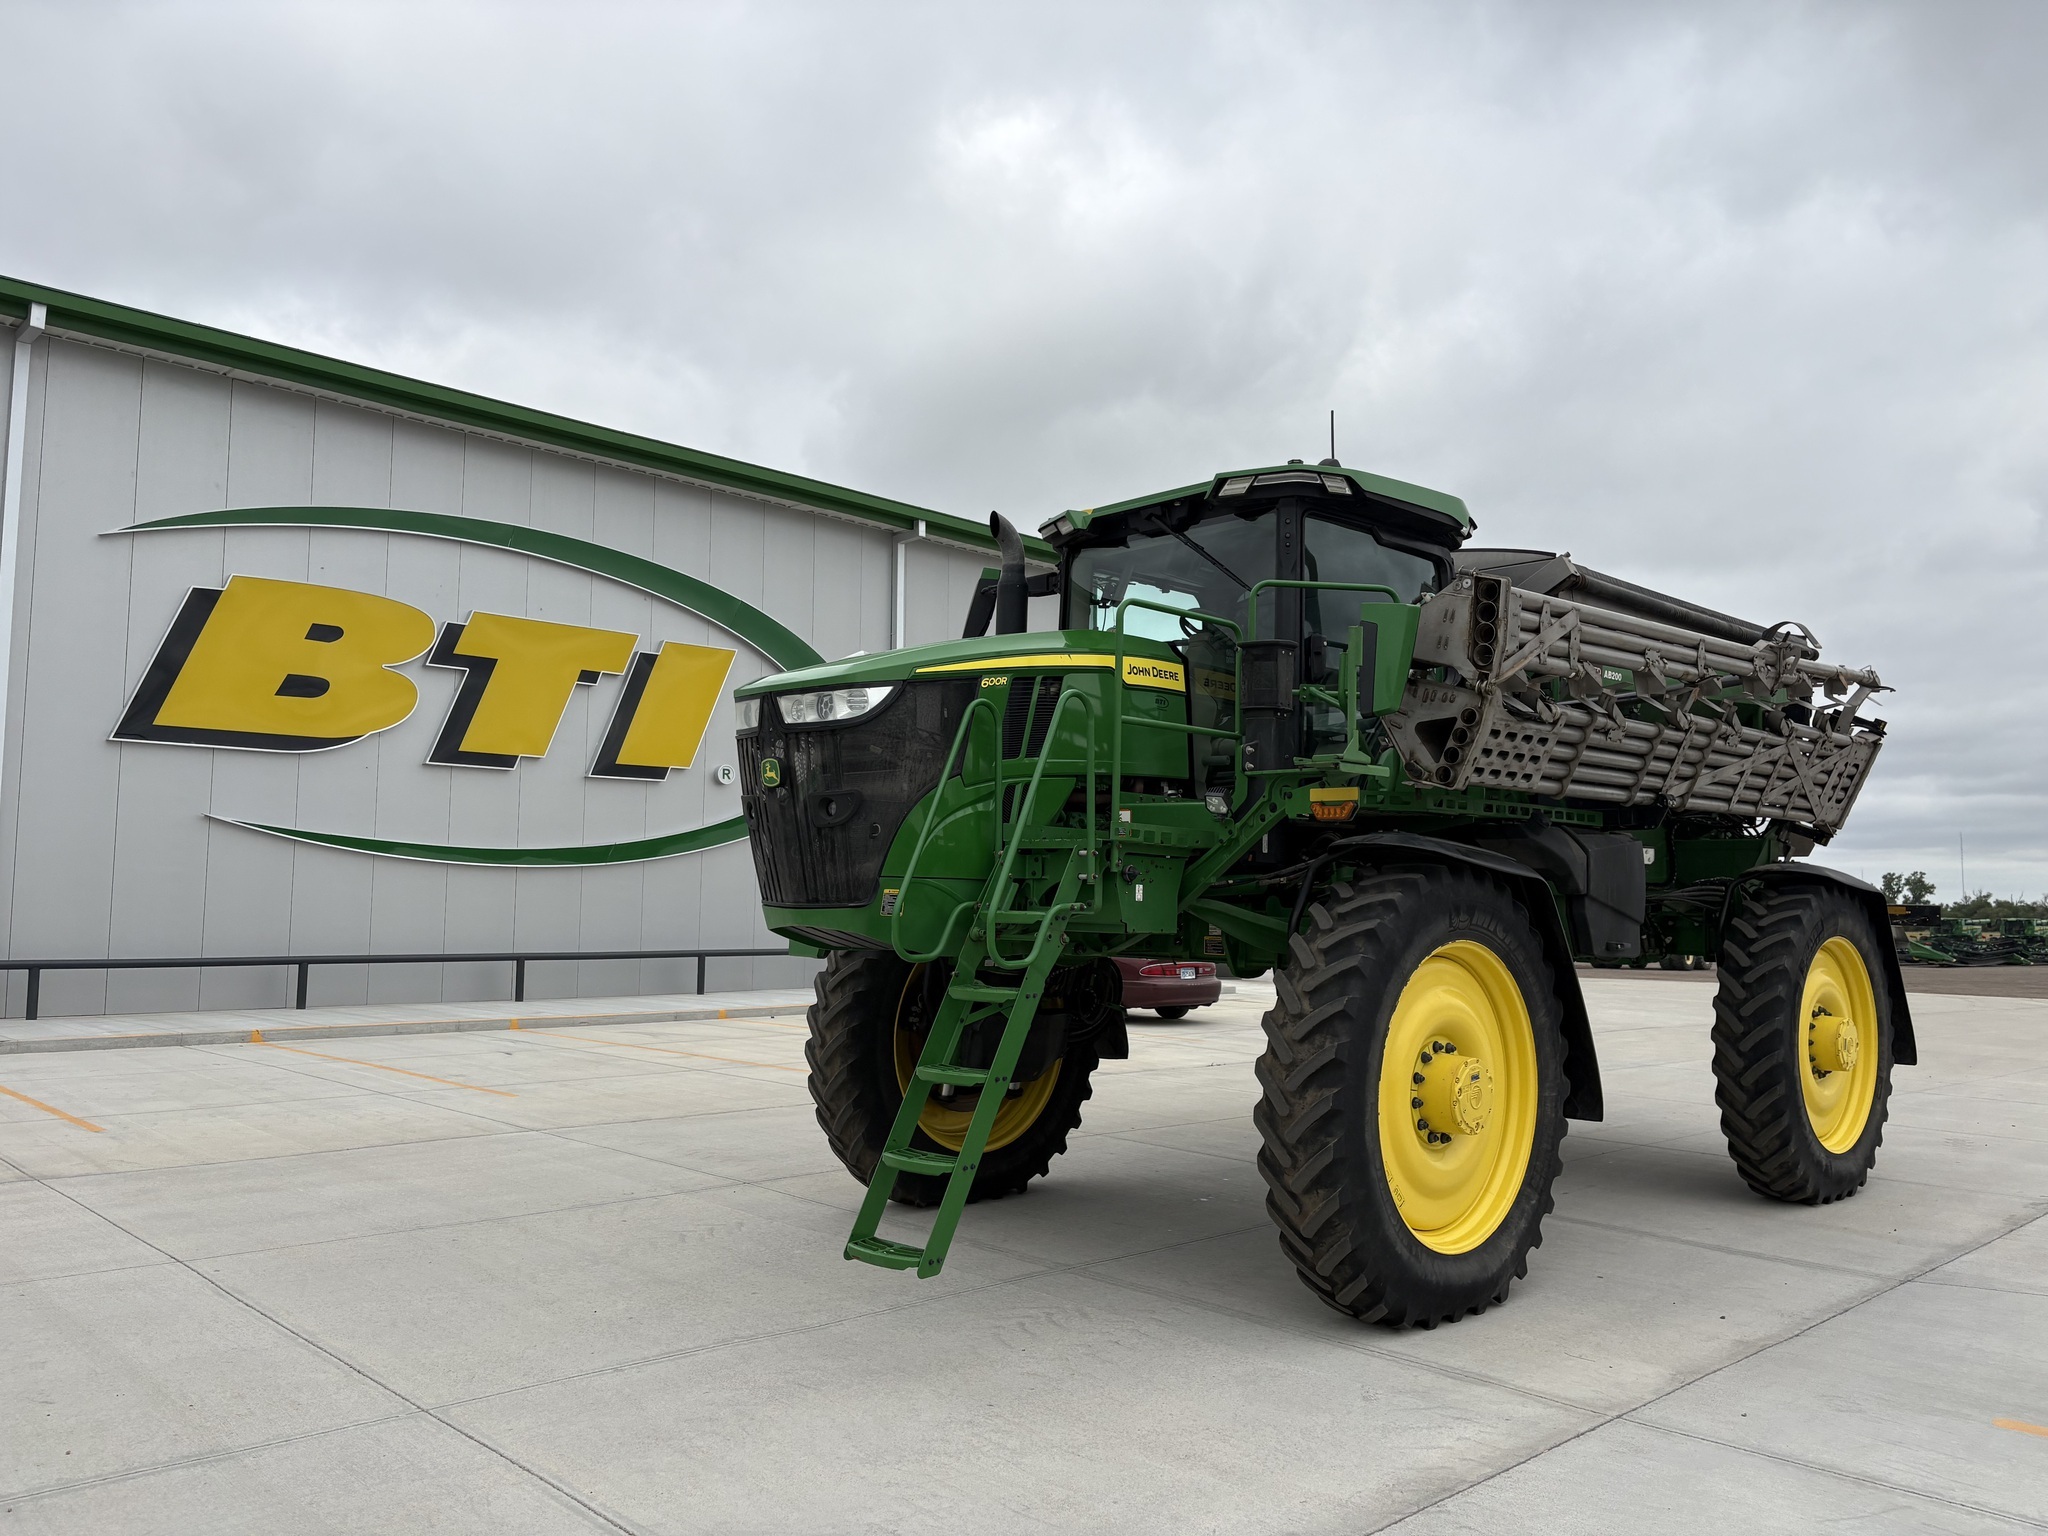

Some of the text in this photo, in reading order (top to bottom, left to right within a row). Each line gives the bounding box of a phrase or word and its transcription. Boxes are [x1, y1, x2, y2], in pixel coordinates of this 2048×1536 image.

[107, 574, 737, 781] BTI
[1127, 663, 1180, 682] JOHN DEERE
[1602, 670, 1622, 681] AB200
[980, 675, 1008, 689] 600R
